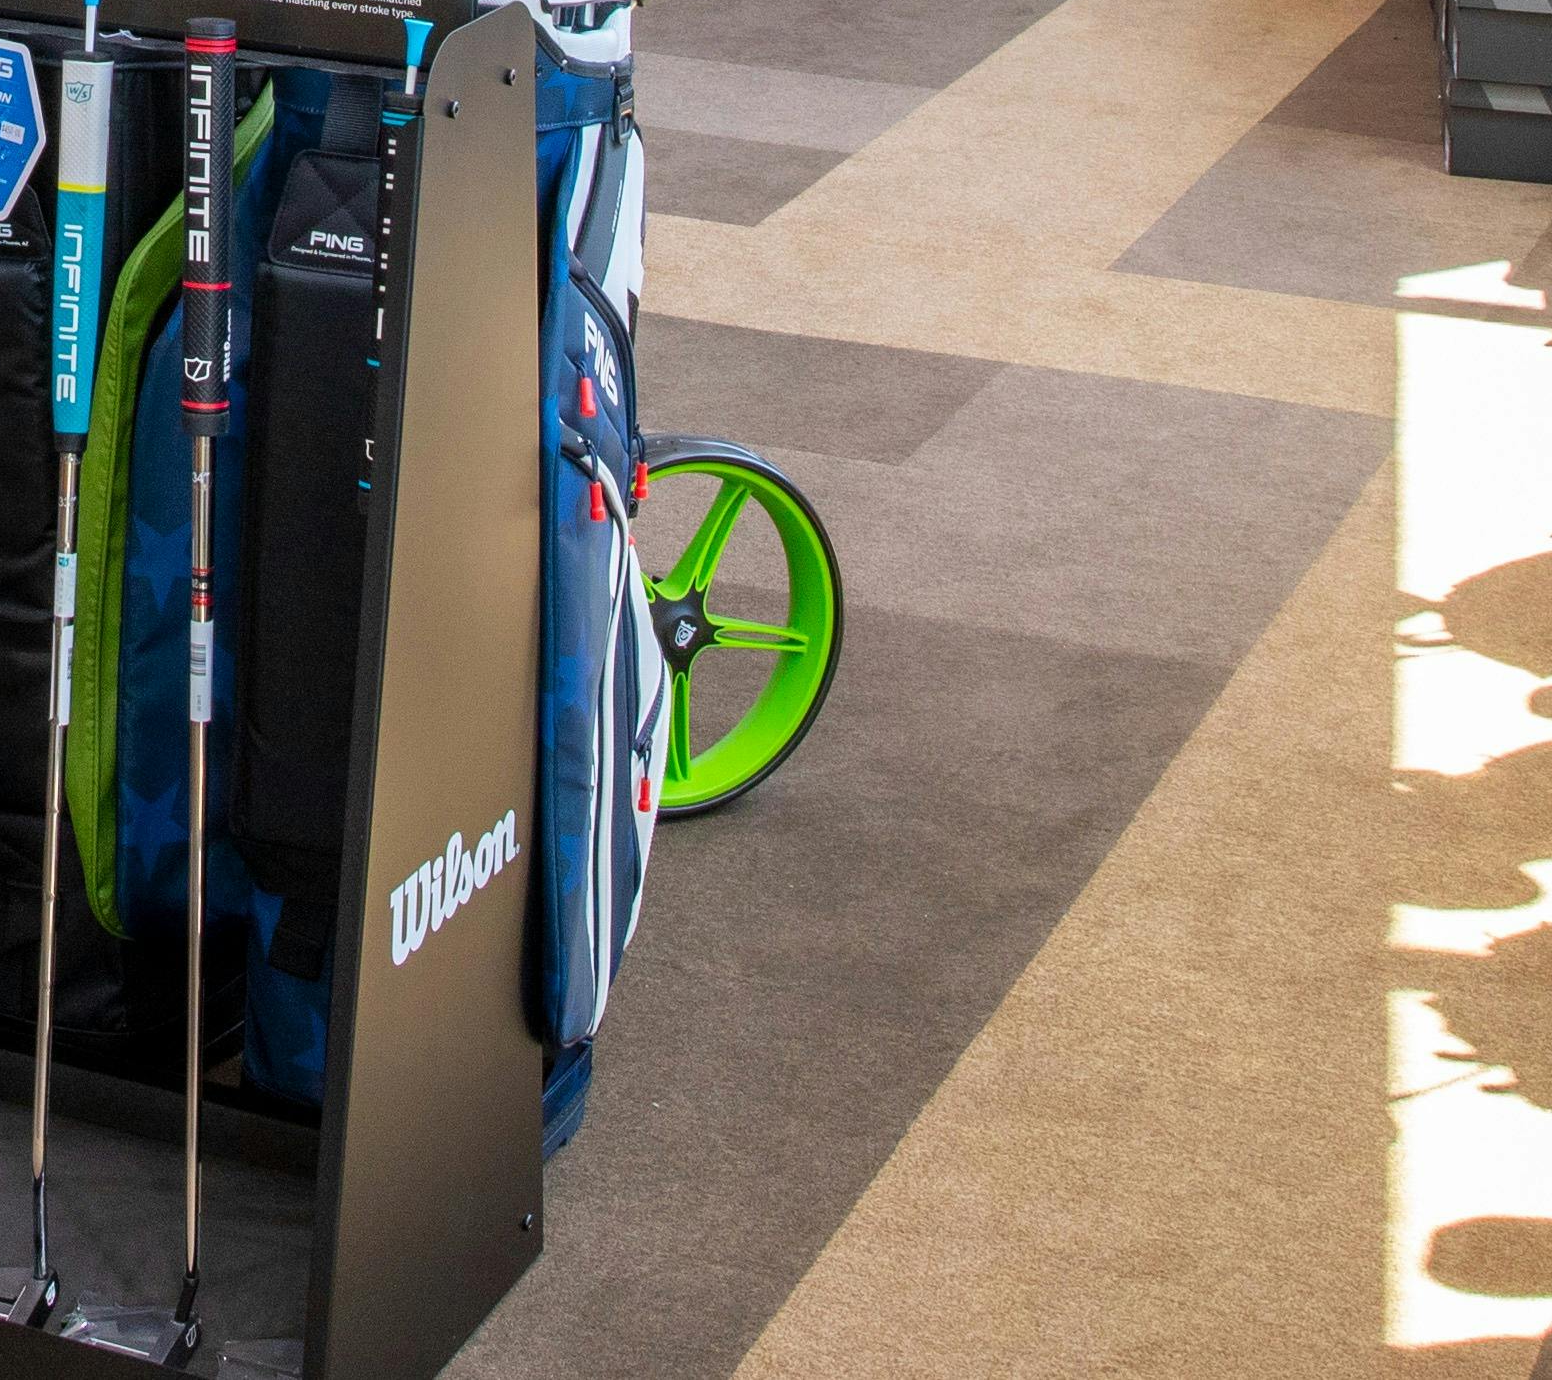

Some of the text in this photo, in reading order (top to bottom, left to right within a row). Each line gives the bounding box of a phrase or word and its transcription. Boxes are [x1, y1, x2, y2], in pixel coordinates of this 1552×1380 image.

[189, 65, 212, 263] INFINITE
[310, 230, 364, 253] PING
[56, 223, 83, 405] INFINITE
[389, 808, 519, 967] Wilson
